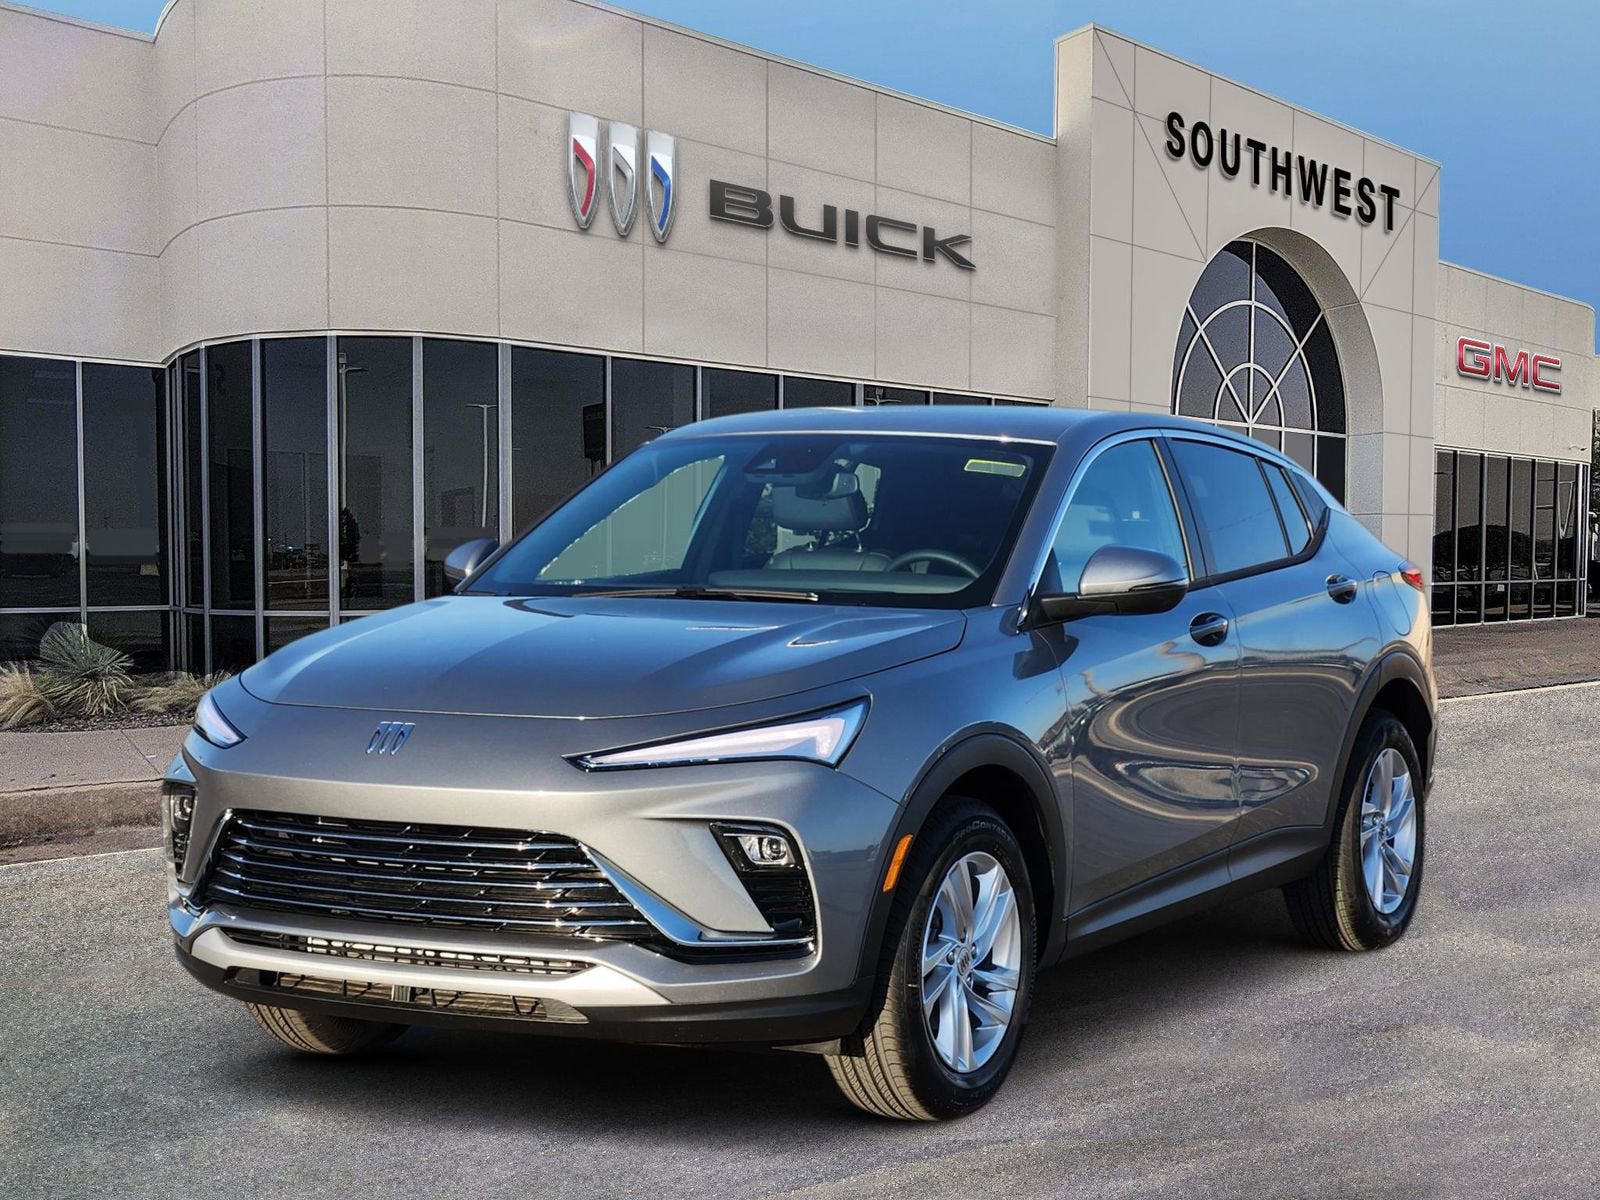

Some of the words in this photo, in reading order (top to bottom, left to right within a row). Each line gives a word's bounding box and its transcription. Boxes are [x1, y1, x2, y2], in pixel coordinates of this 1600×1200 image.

[1166, 112, 1400, 231] SOUTHWEST
[710, 179, 977, 269] BUICK
[1457, 336, 1561, 394] GMC
